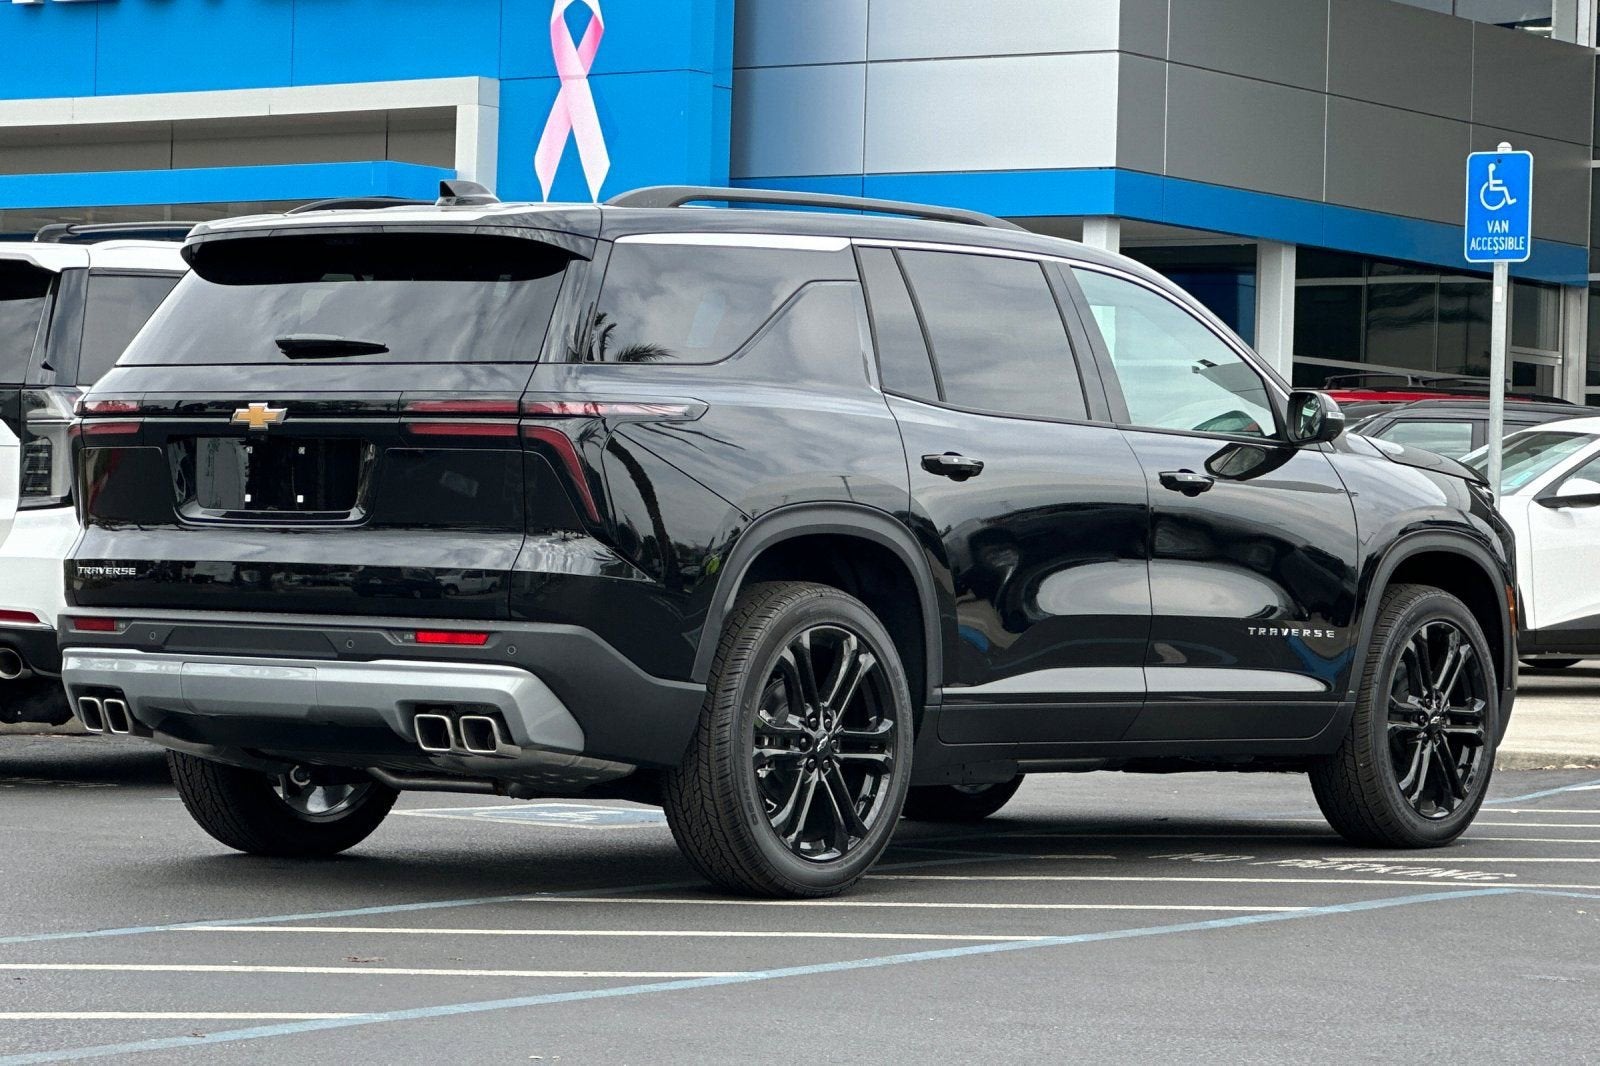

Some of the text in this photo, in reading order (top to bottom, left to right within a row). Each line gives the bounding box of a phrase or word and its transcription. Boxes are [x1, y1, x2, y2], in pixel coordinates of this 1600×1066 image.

[1486, 219, 1510, 234] VAN
[1469, 236, 1526, 251] ACCESSIBLE
[77, 566, 137, 575] TRAVERSE
[1247, 627, 1335, 638] TRAVERSE
[1148, 852, 1517, 881] NO PARKING
